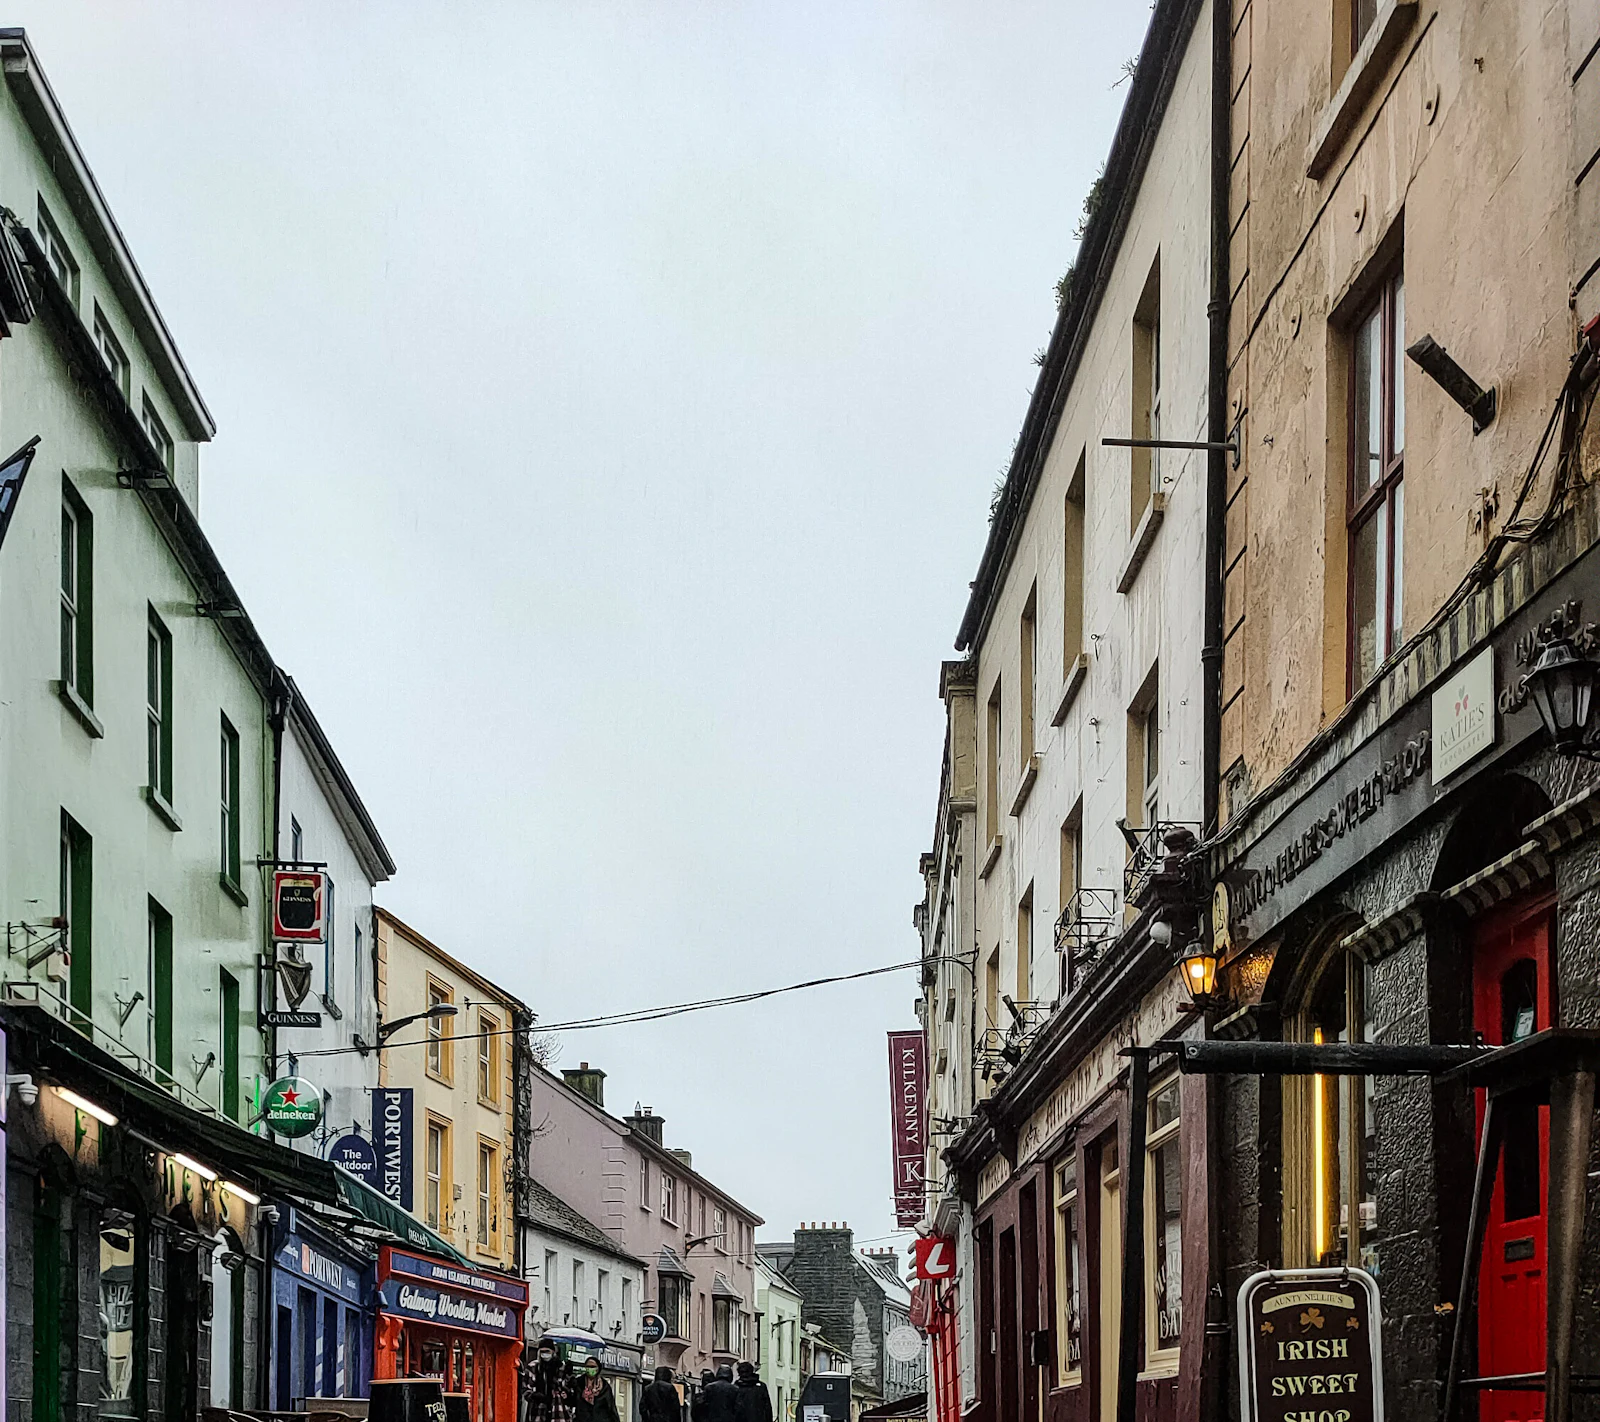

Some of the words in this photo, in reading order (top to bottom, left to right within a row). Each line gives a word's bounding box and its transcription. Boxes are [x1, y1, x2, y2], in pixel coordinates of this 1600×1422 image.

[1440, 702, 1485, 751] KATIE'S
[267, 1012, 317, 1024] GUINNESS
[902, 1048, 919, 1145] KILKENNY
[342, 1149, 362, 1159] The
[903, 1160, 922, 1183] K
[309, 1249, 343, 1291] PORTWEST
[432, 1266, 448, 1279] ARAN
[448, 1271, 471, 1285] ISLANDS
[399, 1285, 437, 1318] Galway
[437, 1293, 476, 1322] Woollen
[476, 1302, 507, 1329] Market
[1274, 1294, 1301, 1307] AUNTY
[1277, 1338, 1349, 1361] IRISH
[1271, 1373, 1359, 1397] SWEET
